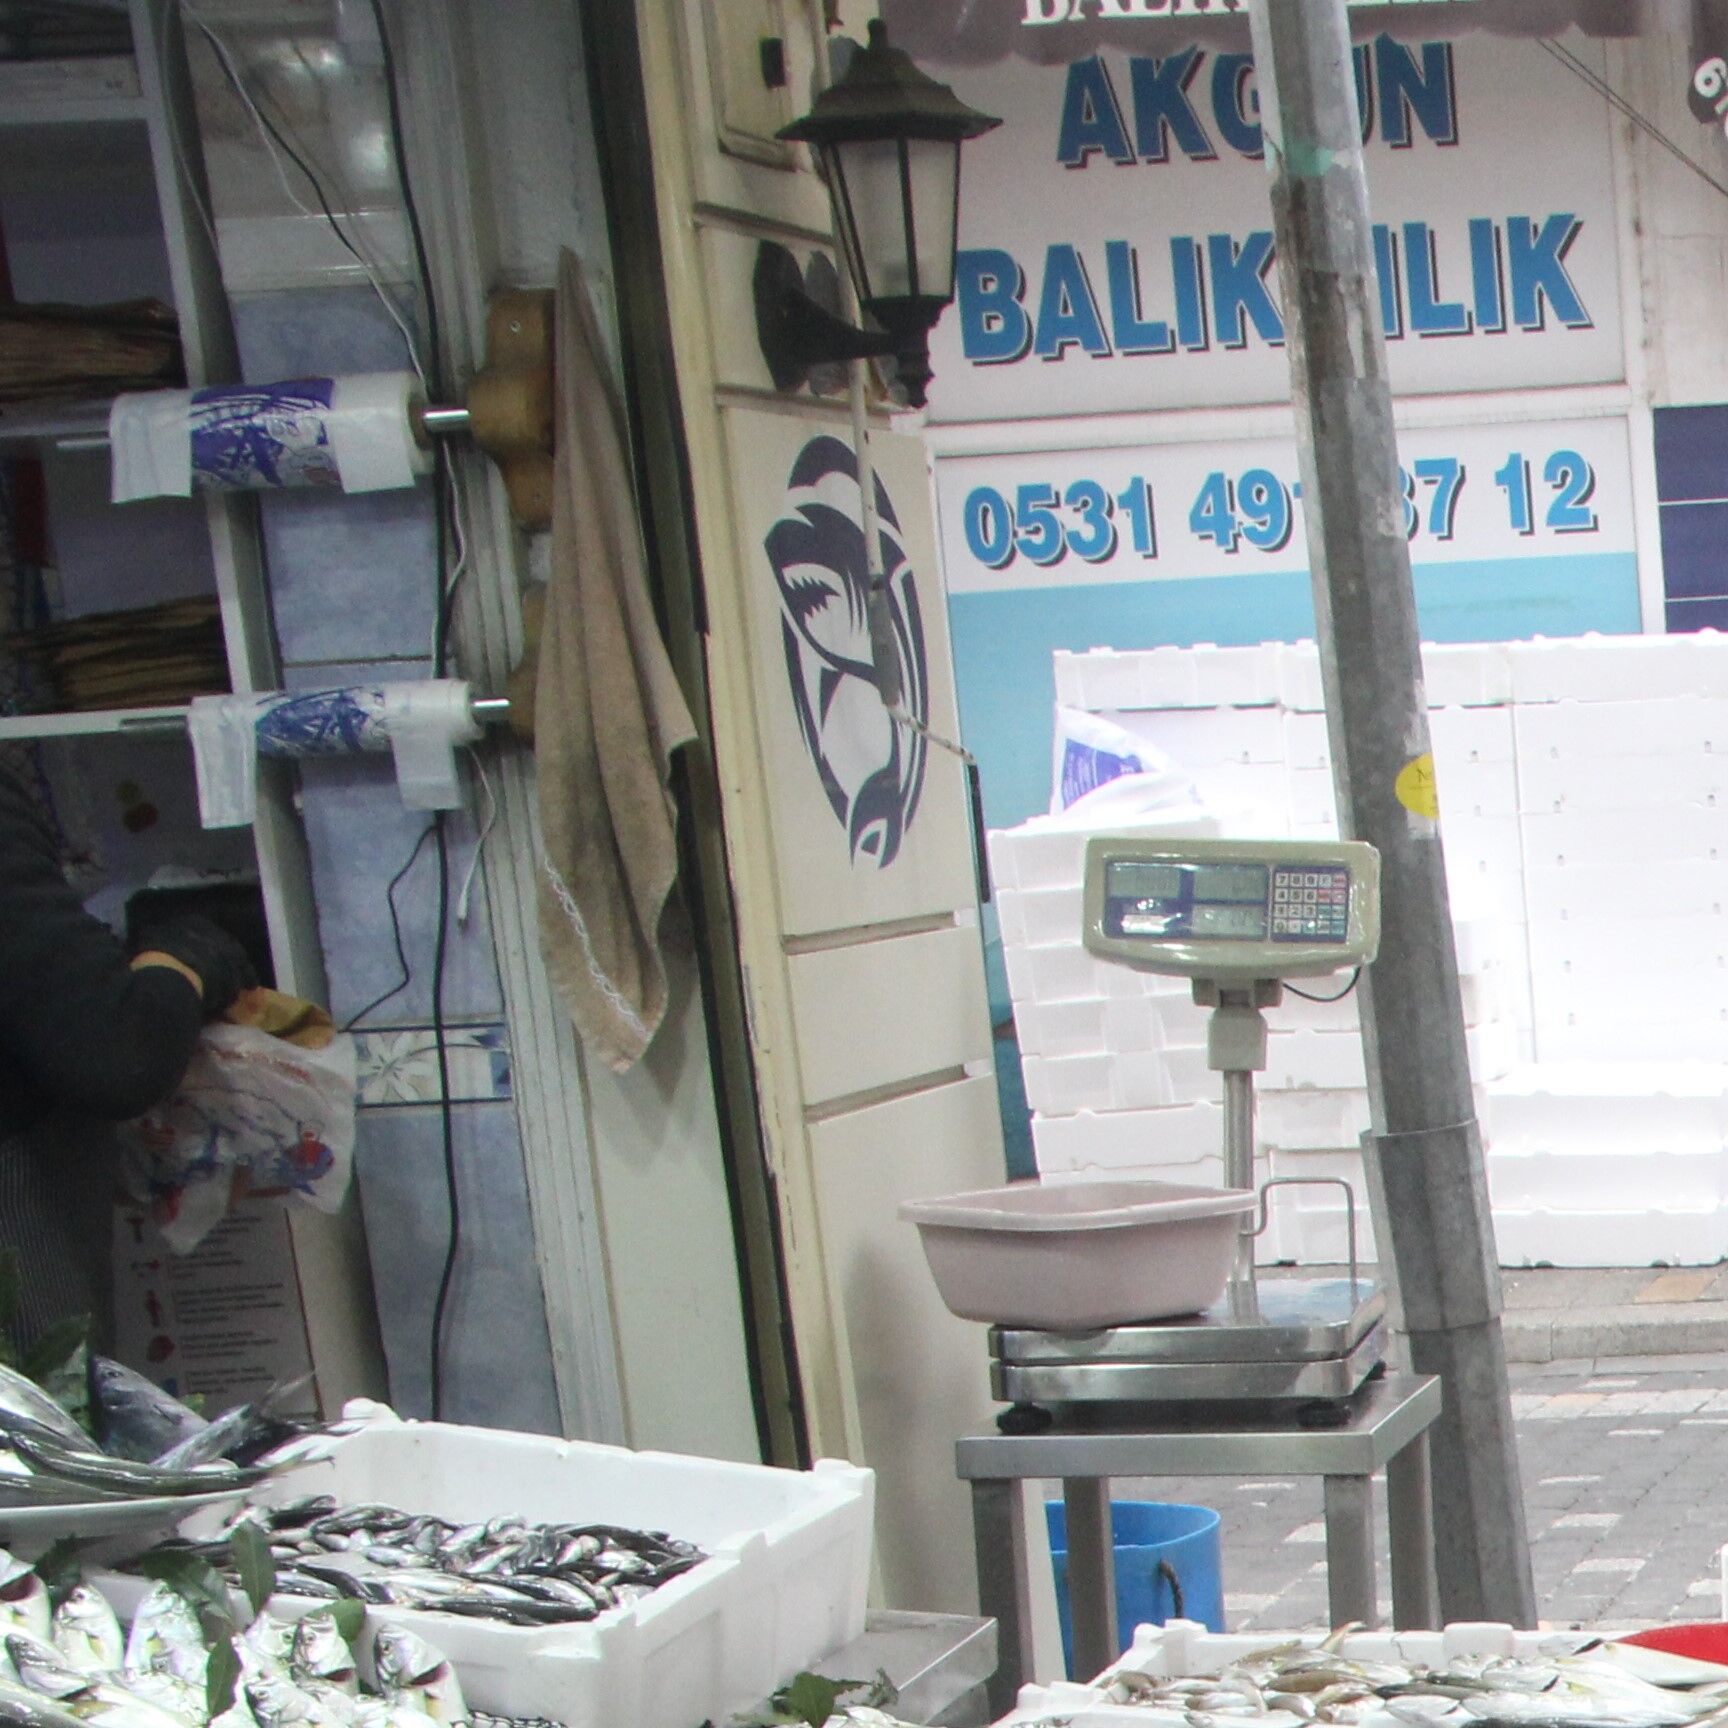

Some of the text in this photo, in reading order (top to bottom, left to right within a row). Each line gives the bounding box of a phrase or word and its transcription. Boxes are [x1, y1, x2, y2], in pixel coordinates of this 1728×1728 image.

[1057, 33, 1457, 167] AKGN
[956, 213, 1592, 364] BALIKILIK
[964, 476, 1156, 568] 0531
[1189, 469, 1300, 554] 49
[1495, 450, 1598, 536] 12
